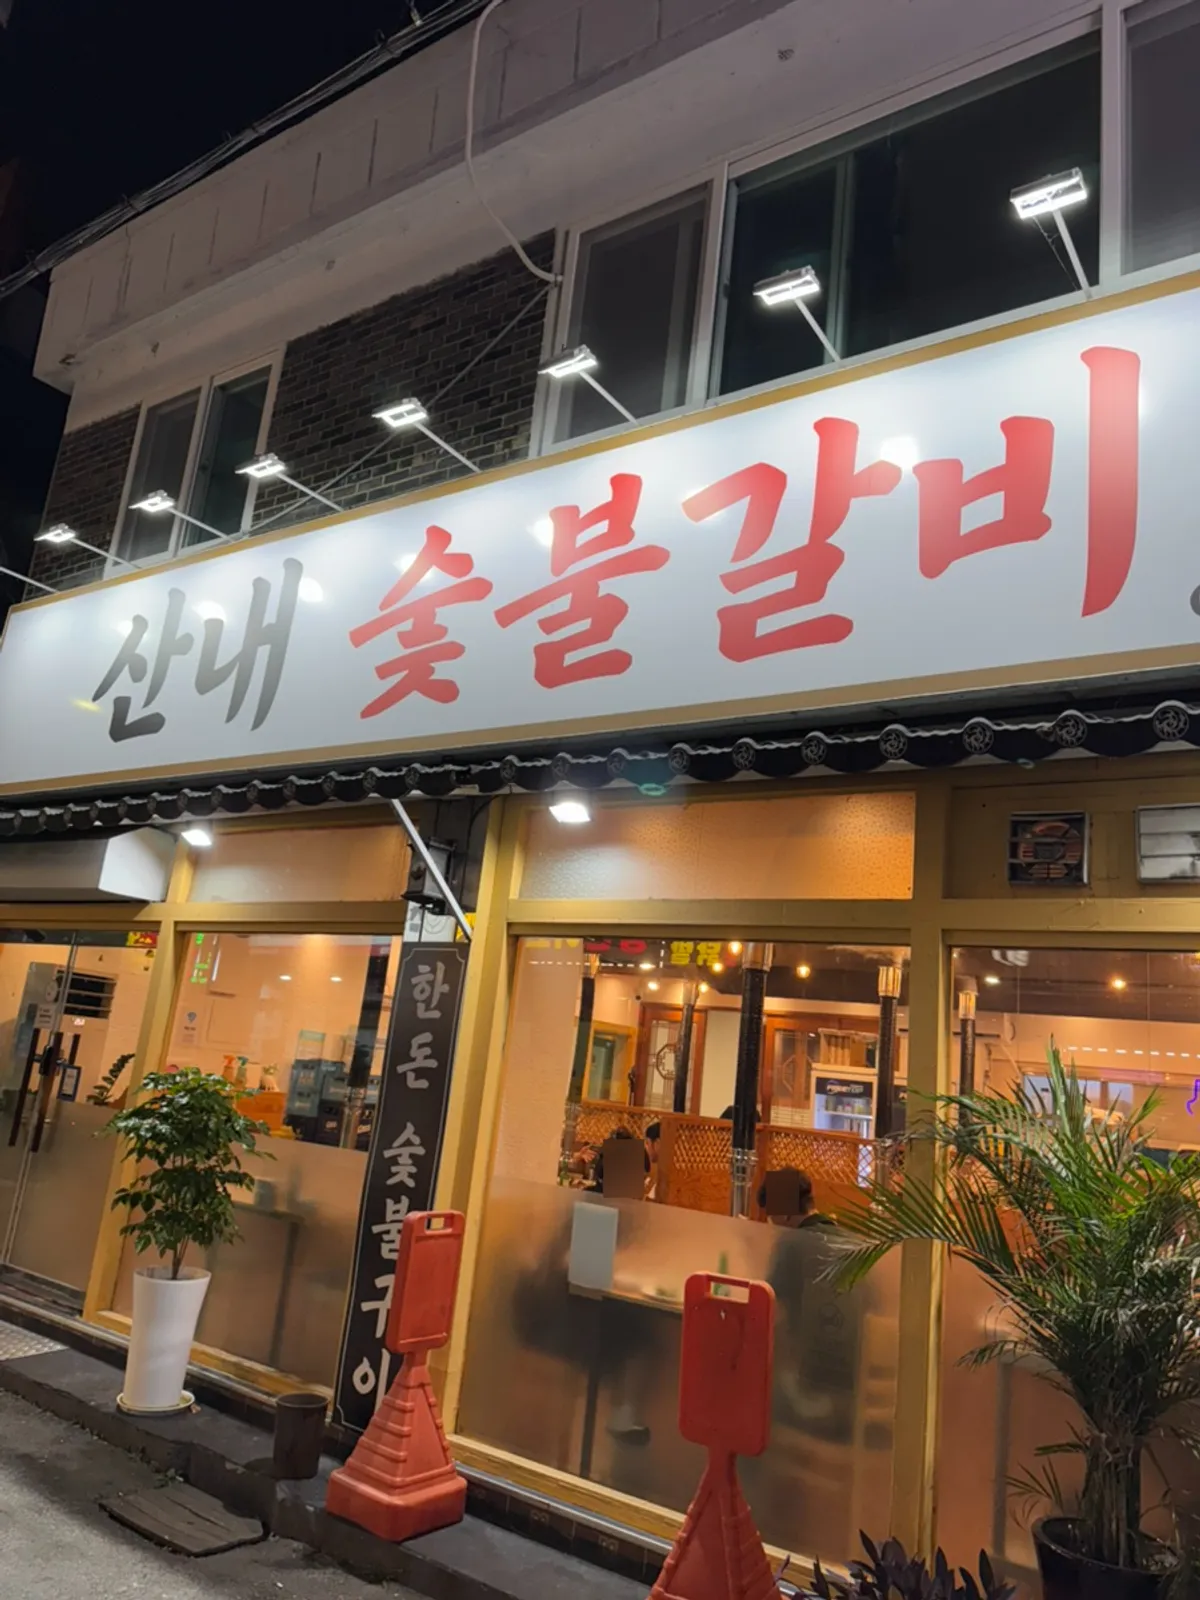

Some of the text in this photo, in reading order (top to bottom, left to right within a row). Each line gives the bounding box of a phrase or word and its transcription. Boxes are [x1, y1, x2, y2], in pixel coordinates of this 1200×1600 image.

[91, 345, 1141, 744] 산내 숯불갈비
[396, 960, 450, 1090] 한돈
